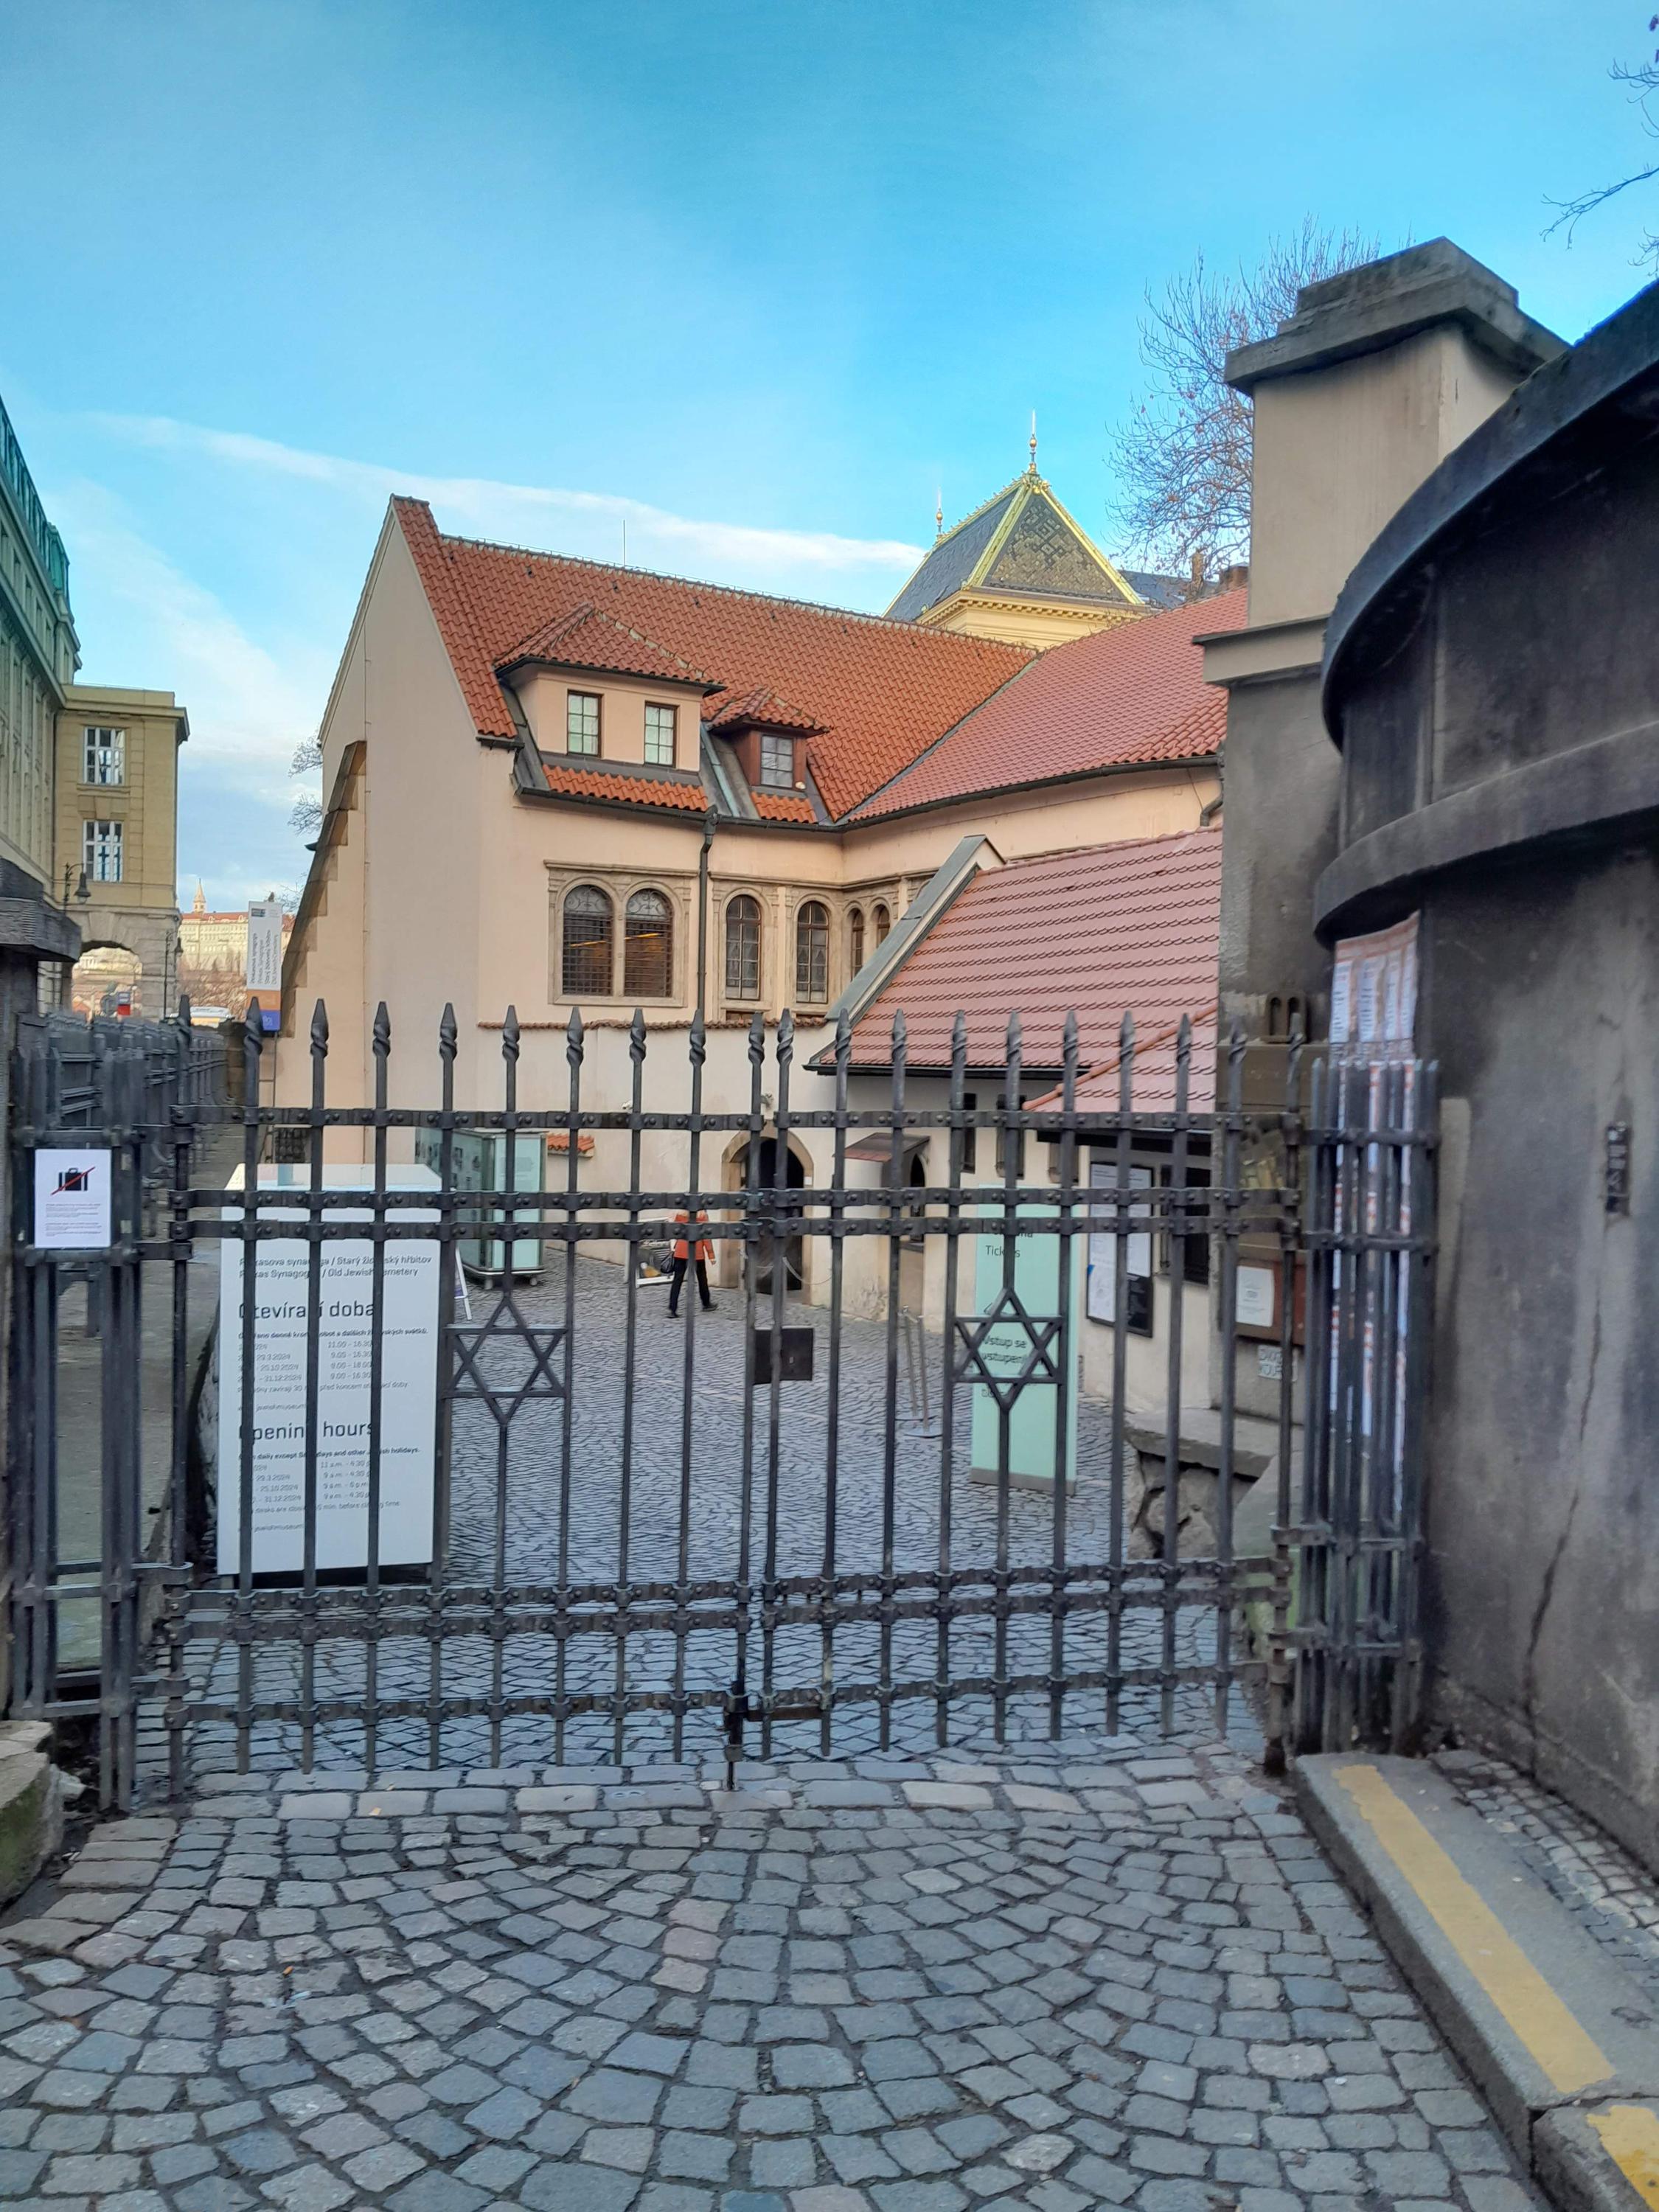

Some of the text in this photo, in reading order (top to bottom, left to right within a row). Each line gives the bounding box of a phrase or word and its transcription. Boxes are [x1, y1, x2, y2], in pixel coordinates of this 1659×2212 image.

[985, 1245, 1020, 1258] Ticks
[240, 1257, 285, 1266] Pasova
[287, 1257, 329, 1267] synaga
[337, 1256, 360, 1267] Starý
[240, 1270, 269, 1279] Pas
[271, 1268, 319, 1279] Synagog
[328, 1267, 342, 1277] Old
[378, 1266, 419, 1276] emetery
[330, 1301, 375, 1316] doba
[983, 1352, 1030, 1366] vstupen
[240, 1421, 372, 1444] penin hours
